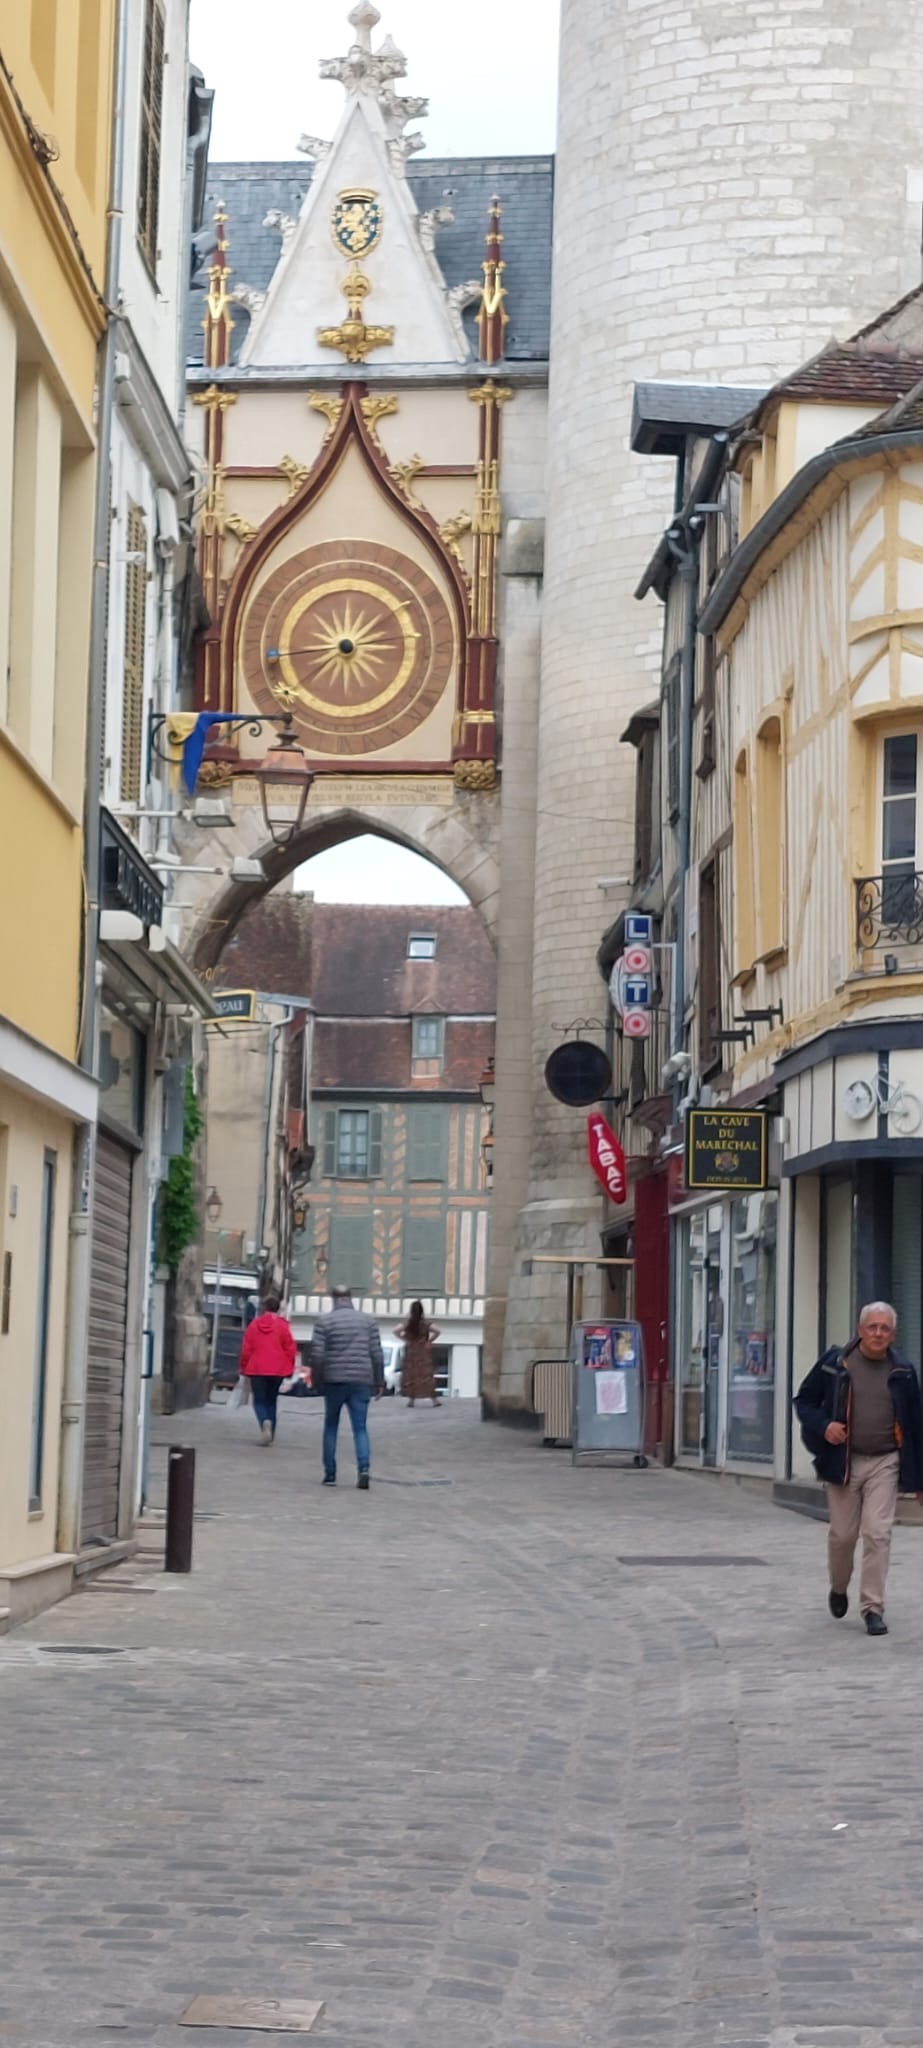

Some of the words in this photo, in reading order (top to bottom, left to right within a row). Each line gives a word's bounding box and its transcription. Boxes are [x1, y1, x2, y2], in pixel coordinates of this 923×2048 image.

[625, 919, 650, 1035] LOTO
[703, 1116, 718, 1126] LA
[721, 1116, 750, 1127] CAVE
[718, 1128, 735, 1139] DU
[592, 1123, 624, 1194] TABAC
